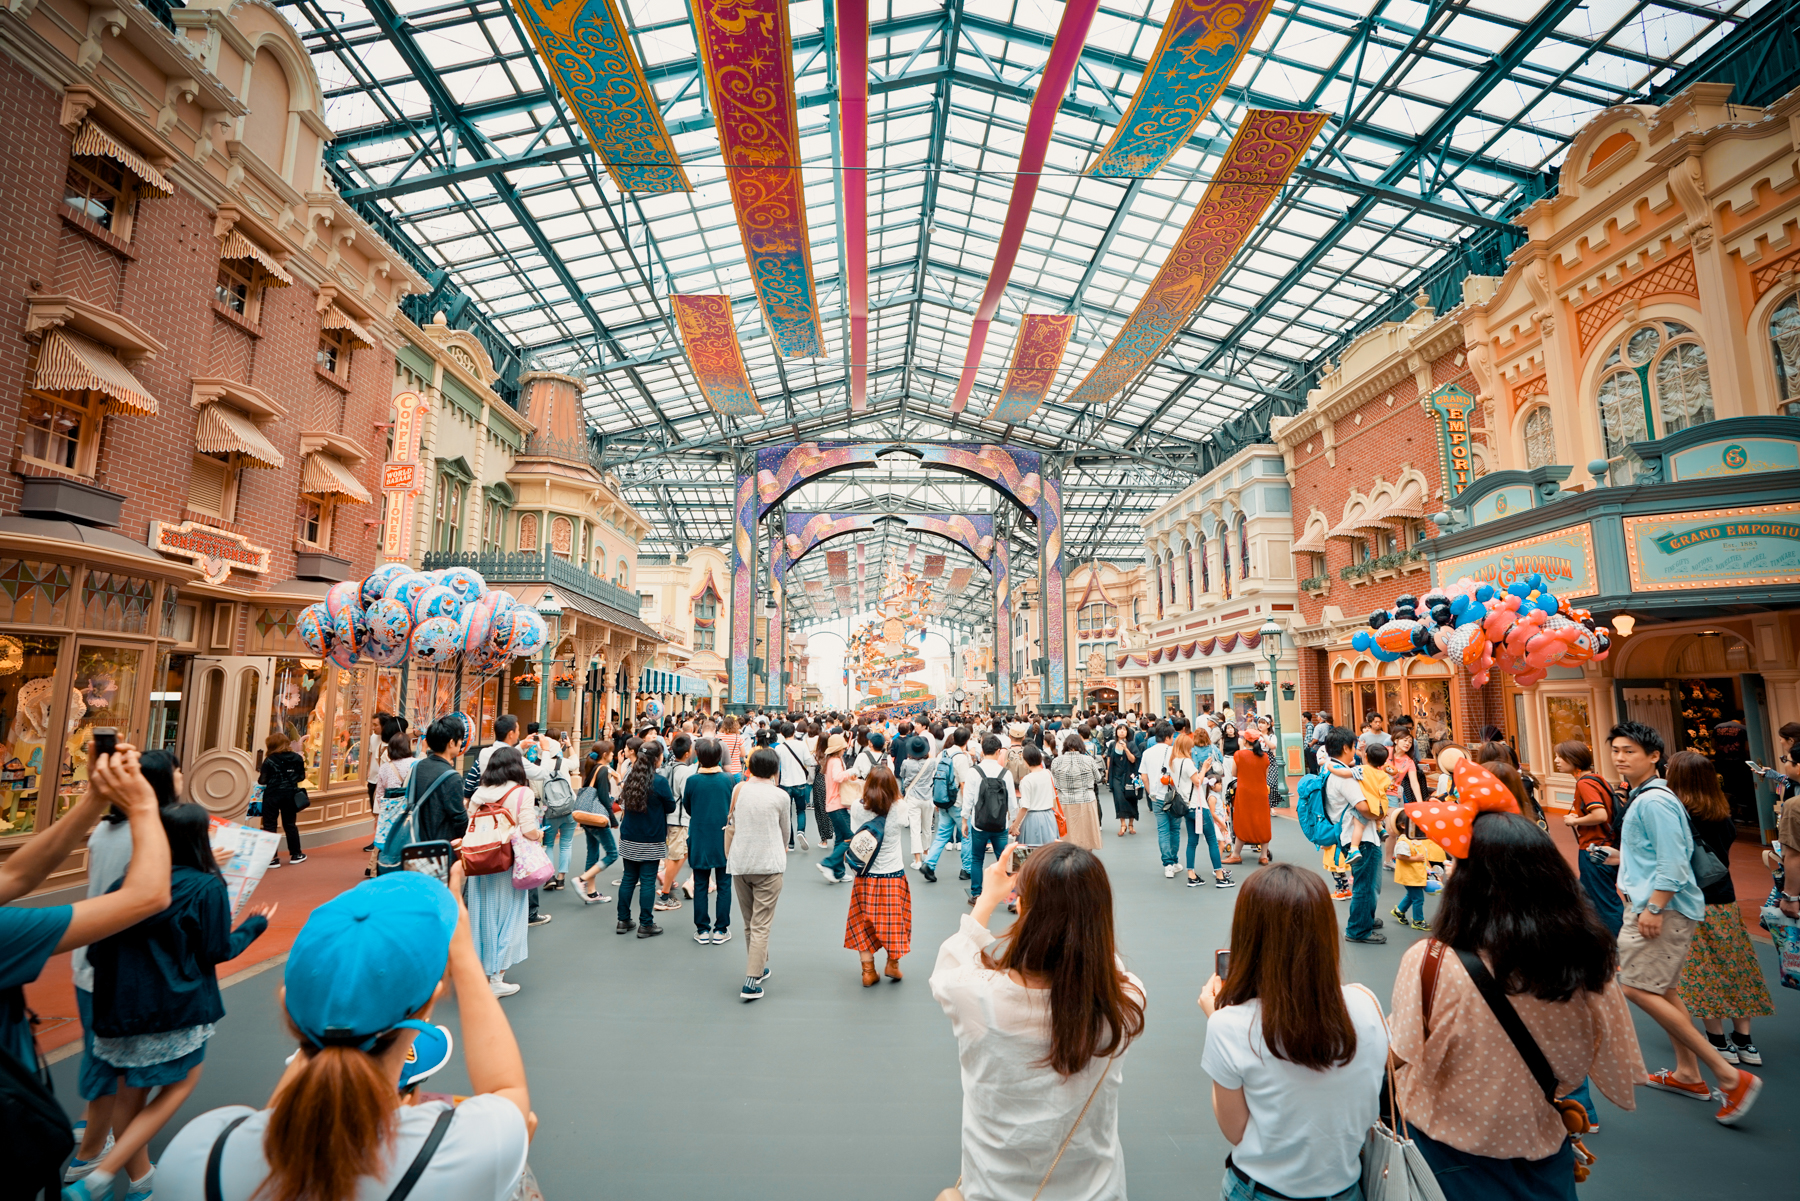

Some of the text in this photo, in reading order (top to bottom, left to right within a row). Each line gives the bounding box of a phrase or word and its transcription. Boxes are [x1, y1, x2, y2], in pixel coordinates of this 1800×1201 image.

[451, 346, 476, 375] 1897
[1435, 395, 1471, 405] GRAND
[386, 467, 413, 479] WORLD
[386, 475, 412, 486] BAZAAR
[1669, 527, 1721, 550] GRAND
[1722, 540, 1758, 550] Est. 1883
[161, 531, 260, 566] CONFECTIONERY
[1691, 556, 1714, 572] NOTIONS
[1715, 554, 1743, 571] NOVELTIES
[1742, 552, 1767, 569] APPAREL
[1770, 550, 1797, 567] TINWARE
[1498, 551, 1574, 588] EMPORIUM
[1690, 570, 1747, 578] EVERYTHING
